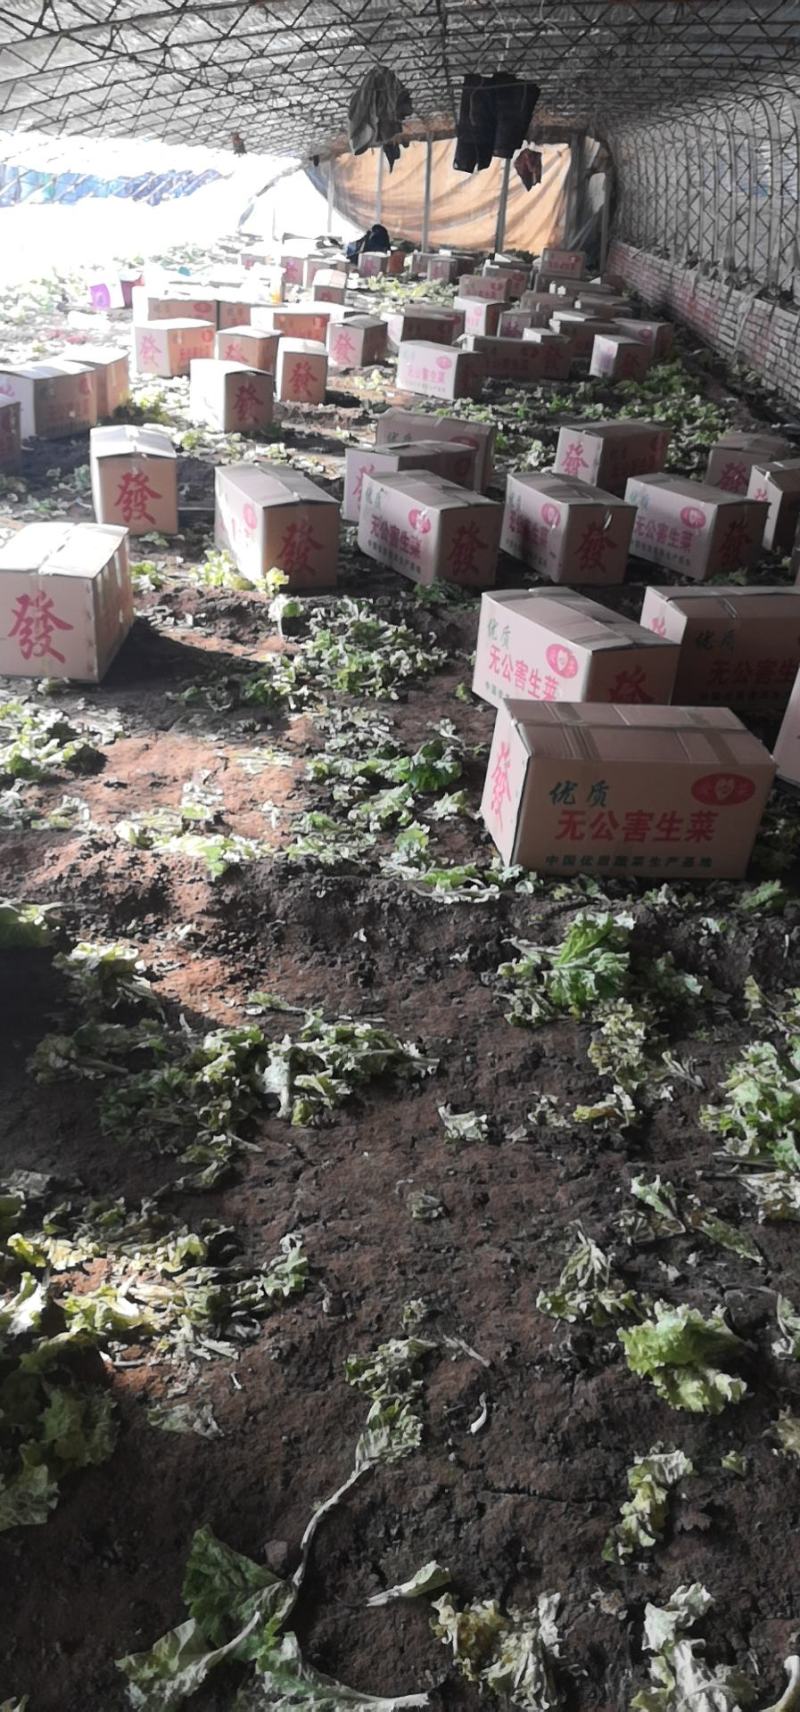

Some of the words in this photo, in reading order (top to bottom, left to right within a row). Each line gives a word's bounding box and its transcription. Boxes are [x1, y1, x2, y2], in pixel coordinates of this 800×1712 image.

[233, 382, 265, 422] 發
[290, 361, 317, 398] 發
[115, 470, 162, 524] 發
[278, 519, 323, 576] 發
[448, 520, 489, 577] 發
[575, 521, 617, 573] 發
[635, 515, 694, 554] 无公害生菜
[7, 591, 74, 664] 發
[488, 645, 559, 701] 无公害生菜
[706, 657, 796, 685] 无公害生
[550, 779, 610, 808] 优质
[555, 809, 719, 843] 无公害生菜
